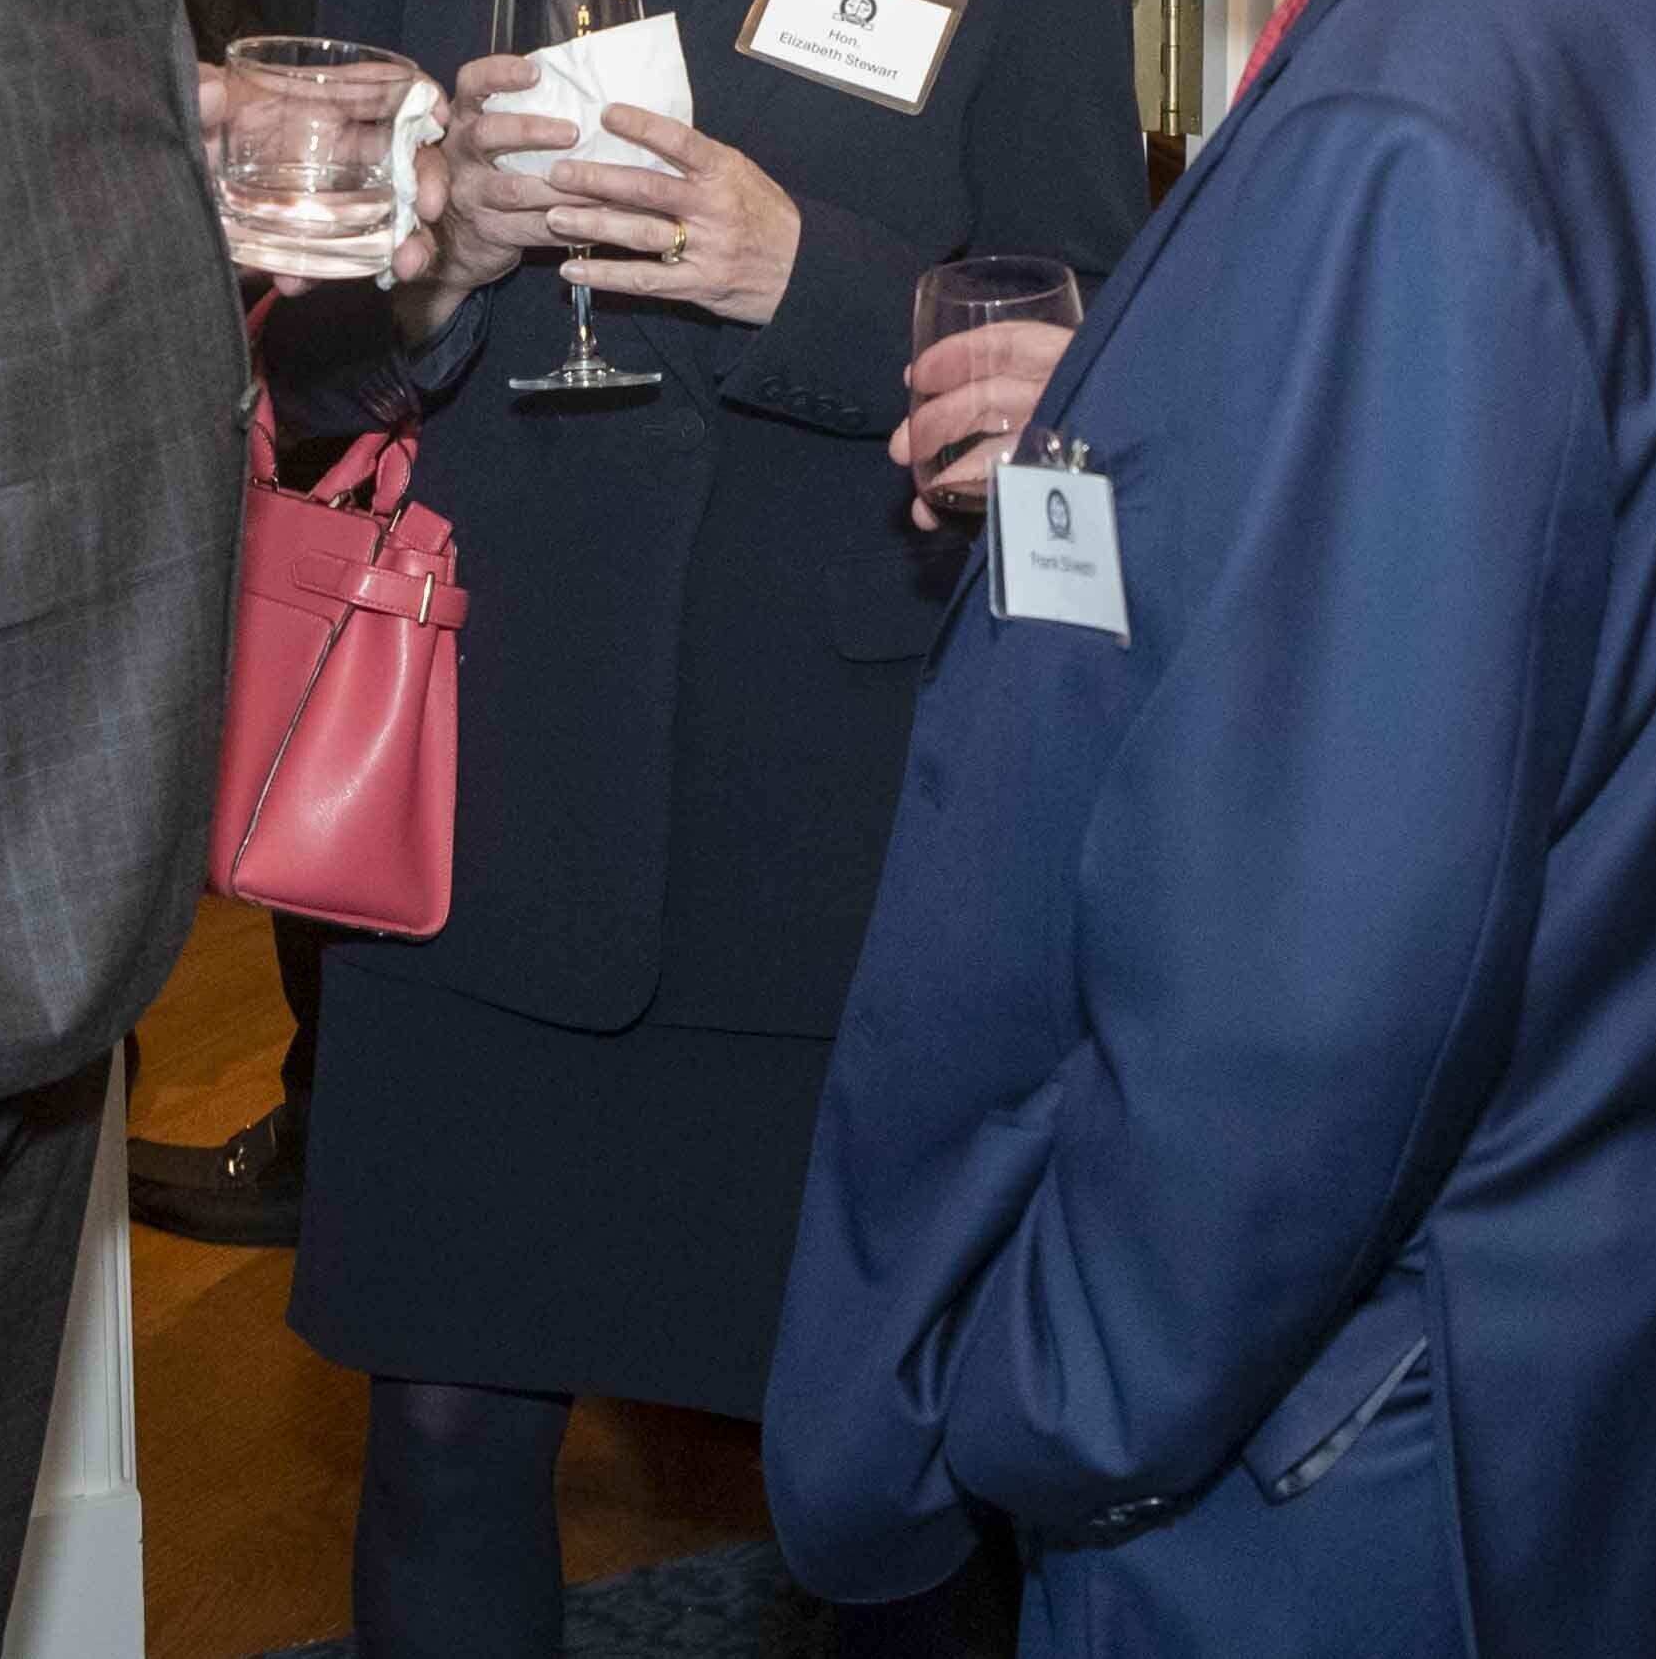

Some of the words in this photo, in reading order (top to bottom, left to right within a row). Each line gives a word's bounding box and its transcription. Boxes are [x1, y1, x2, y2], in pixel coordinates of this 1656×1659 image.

[829, 28, 860, 48] Hon.
[779, 31, 842, 62] Elizabeth
[845, 52, 899, 80] Stewart
